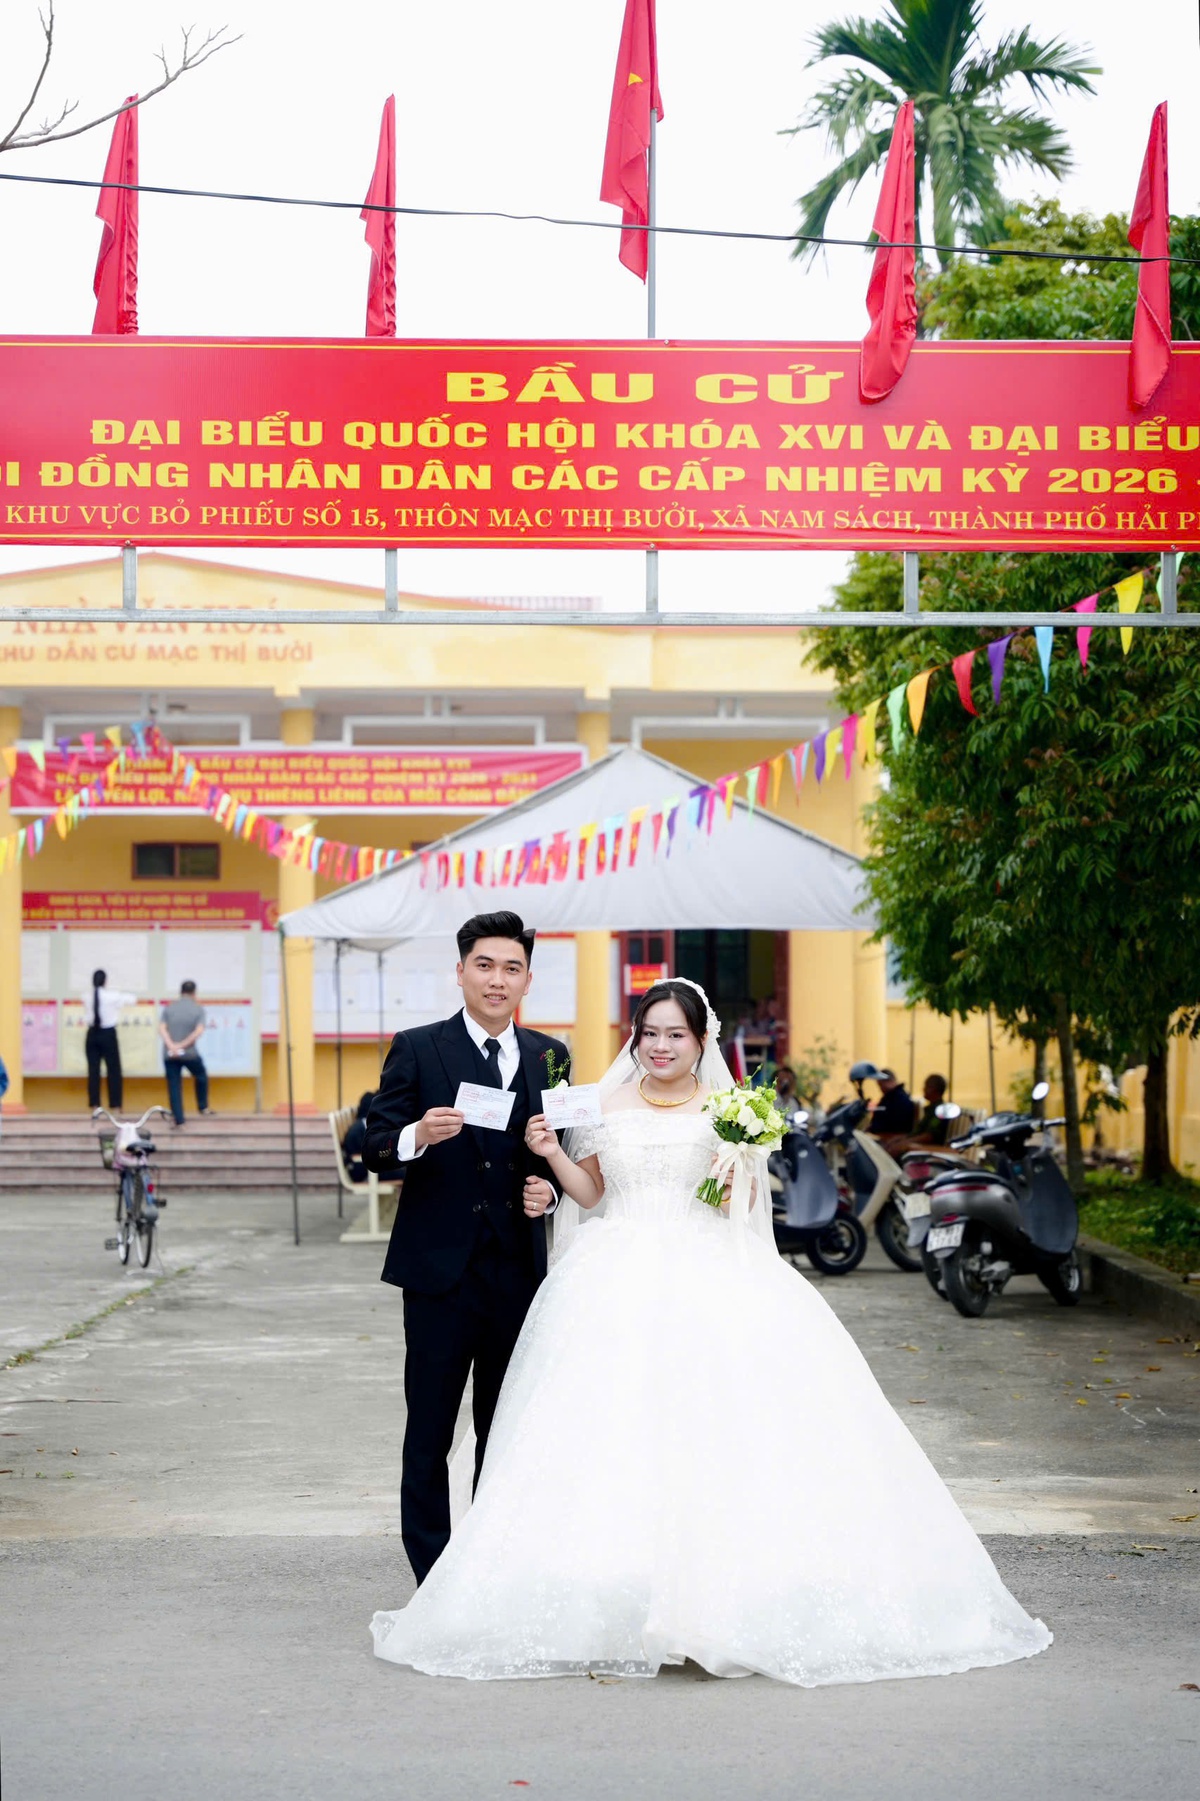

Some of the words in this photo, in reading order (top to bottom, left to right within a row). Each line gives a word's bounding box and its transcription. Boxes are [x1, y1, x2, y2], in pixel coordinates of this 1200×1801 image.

[446, 361, 653, 404] BẦU
[695, 363, 844, 404] CỬ
[90, 420, 180, 451] ĐẠI
[201, 411, 323, 446] BIỂU
[344, 413, 487, 449] QUỐC
[507, 416, 595, 453] HỘI
[616, 418, 760, 449] KHÓA
[780, 424, 864, 450] XVI
[883, 420, 952, 450] VÀ
[968, 425, 1059, 454] ĐẠI
[1079, 415, 1200, 451] BIỂU
[0, 461, 20, 487] I
[39, 453, 189, 488] ĐỒNG
[210, 458, 361, 488] NHÂN
[381, 459, 492, 489] DÂN
[511, 459, 618, 490] CÁC
[640, 456, 746, 490] CẤP
[766, 461, 942, 496] NHIỆM
[962, 460, 1029, 493] KỲ
[1048, 468, 1178, 493] 2026
[5, 505, 69, 524] KHU
[78, 503, 140, 530] VỰC
[149, 498, 190, 524] BỎ
[201, 498, 295, 525] PHIẾU
[303, 498, 342, 525] SỐ
[351, 508, 387, 530] 15,
[395, 501, 481, 526] THÔN
[488, 508, 553, 532] MẠC
[561, 508, 614, 533] THỊ
[623, 501, 704, 531] BƯỞI,
[712, 504, 752, 527] XÃ
[760, 510, 825, 528] NAM
[833, 503, 921, 531] SÁCH,
[930, 504, 1034, 529] THÀNH
[1046, 501, 1107, 529] PHỐ
[1117, 502, 1169, 529] HẢI
[1177, 511, 1200, 530] P
[0, 645, 34, 662] HU
[47, 639, 97, 662] DÂN
[105, 643, 136, 662] CƯ
